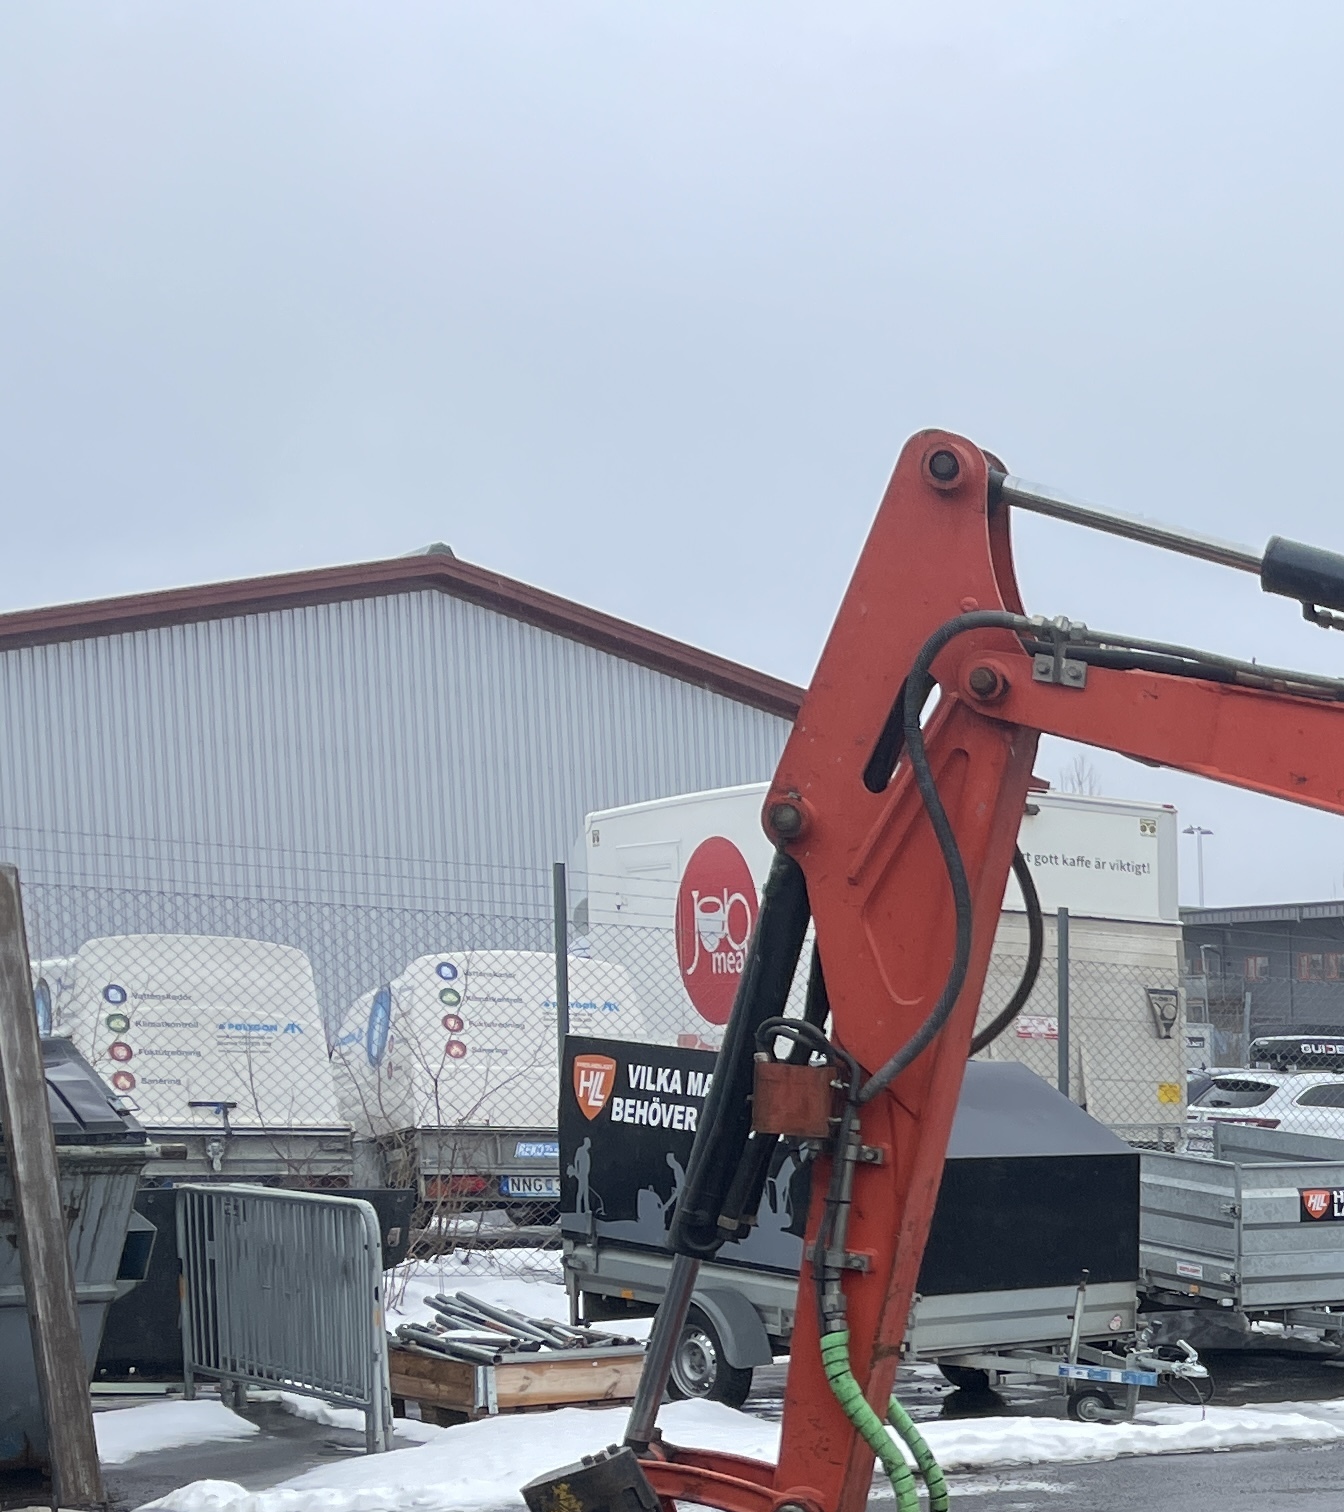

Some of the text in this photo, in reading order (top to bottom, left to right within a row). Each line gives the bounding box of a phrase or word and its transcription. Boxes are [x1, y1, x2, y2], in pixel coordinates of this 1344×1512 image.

[1034, 854, 1058, 866] gott
[1062, 856, 1091, 868] kaffe
[1095, 858, 1106, 869] är
[1109, 860, 1150, 875] viktigt!
[628, 1064, 715, 1098] VILKA MA
[611, 1094, 698, 1132] BEHÖVER
[511, 1178, 542, 1191] NNG
[1308, 1194, 1327, 1211] HLL
